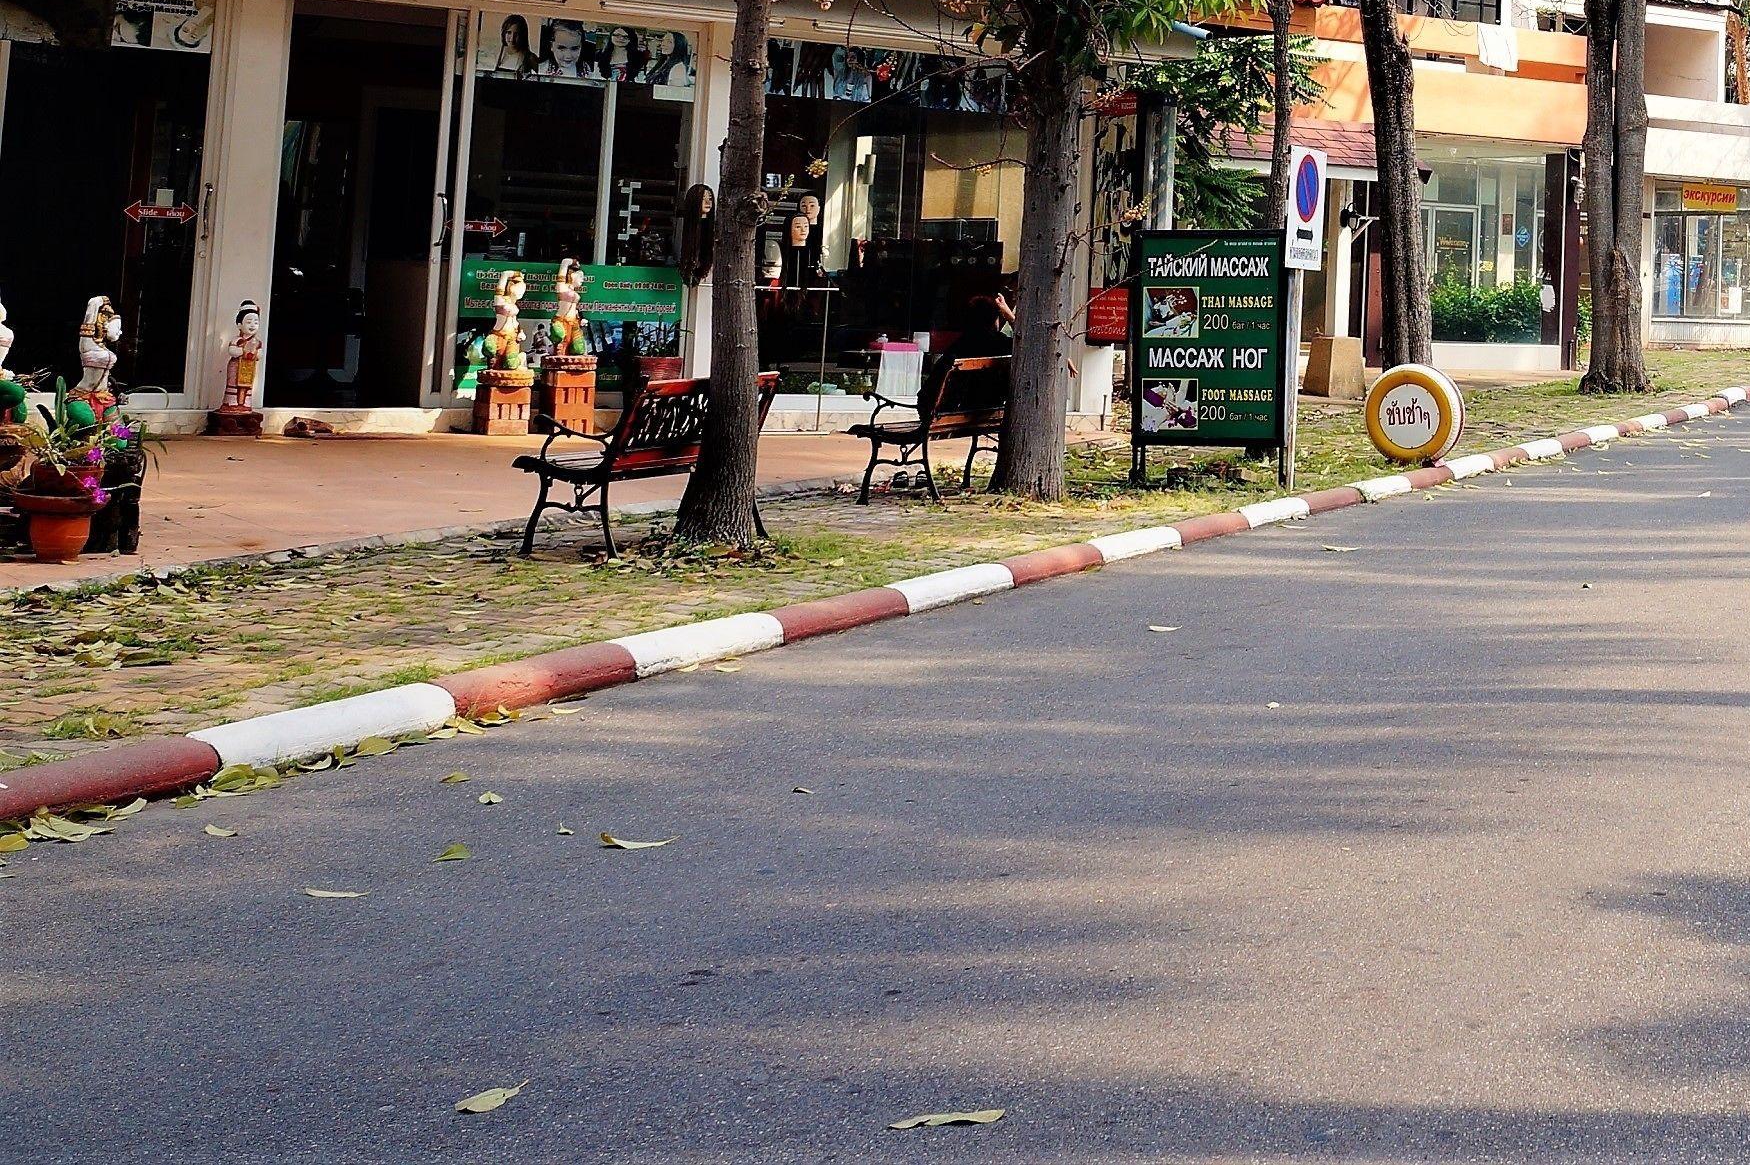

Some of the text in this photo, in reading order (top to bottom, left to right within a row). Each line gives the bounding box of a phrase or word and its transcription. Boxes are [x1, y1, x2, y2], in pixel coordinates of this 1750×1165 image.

[1148, 253, 1269, 277] ТАЙСКИЙ МАССАЖ
[1201, 295, 1274, 308] THAI MASSAGE
[1203, 313, 1229, 330] 200
[1149, 347, 1268, 369] МАССАЖ НОГ
[1201, 389, 1273, 401] FOOT MASSAGE
[1200, 405, 1226, 421] 200
